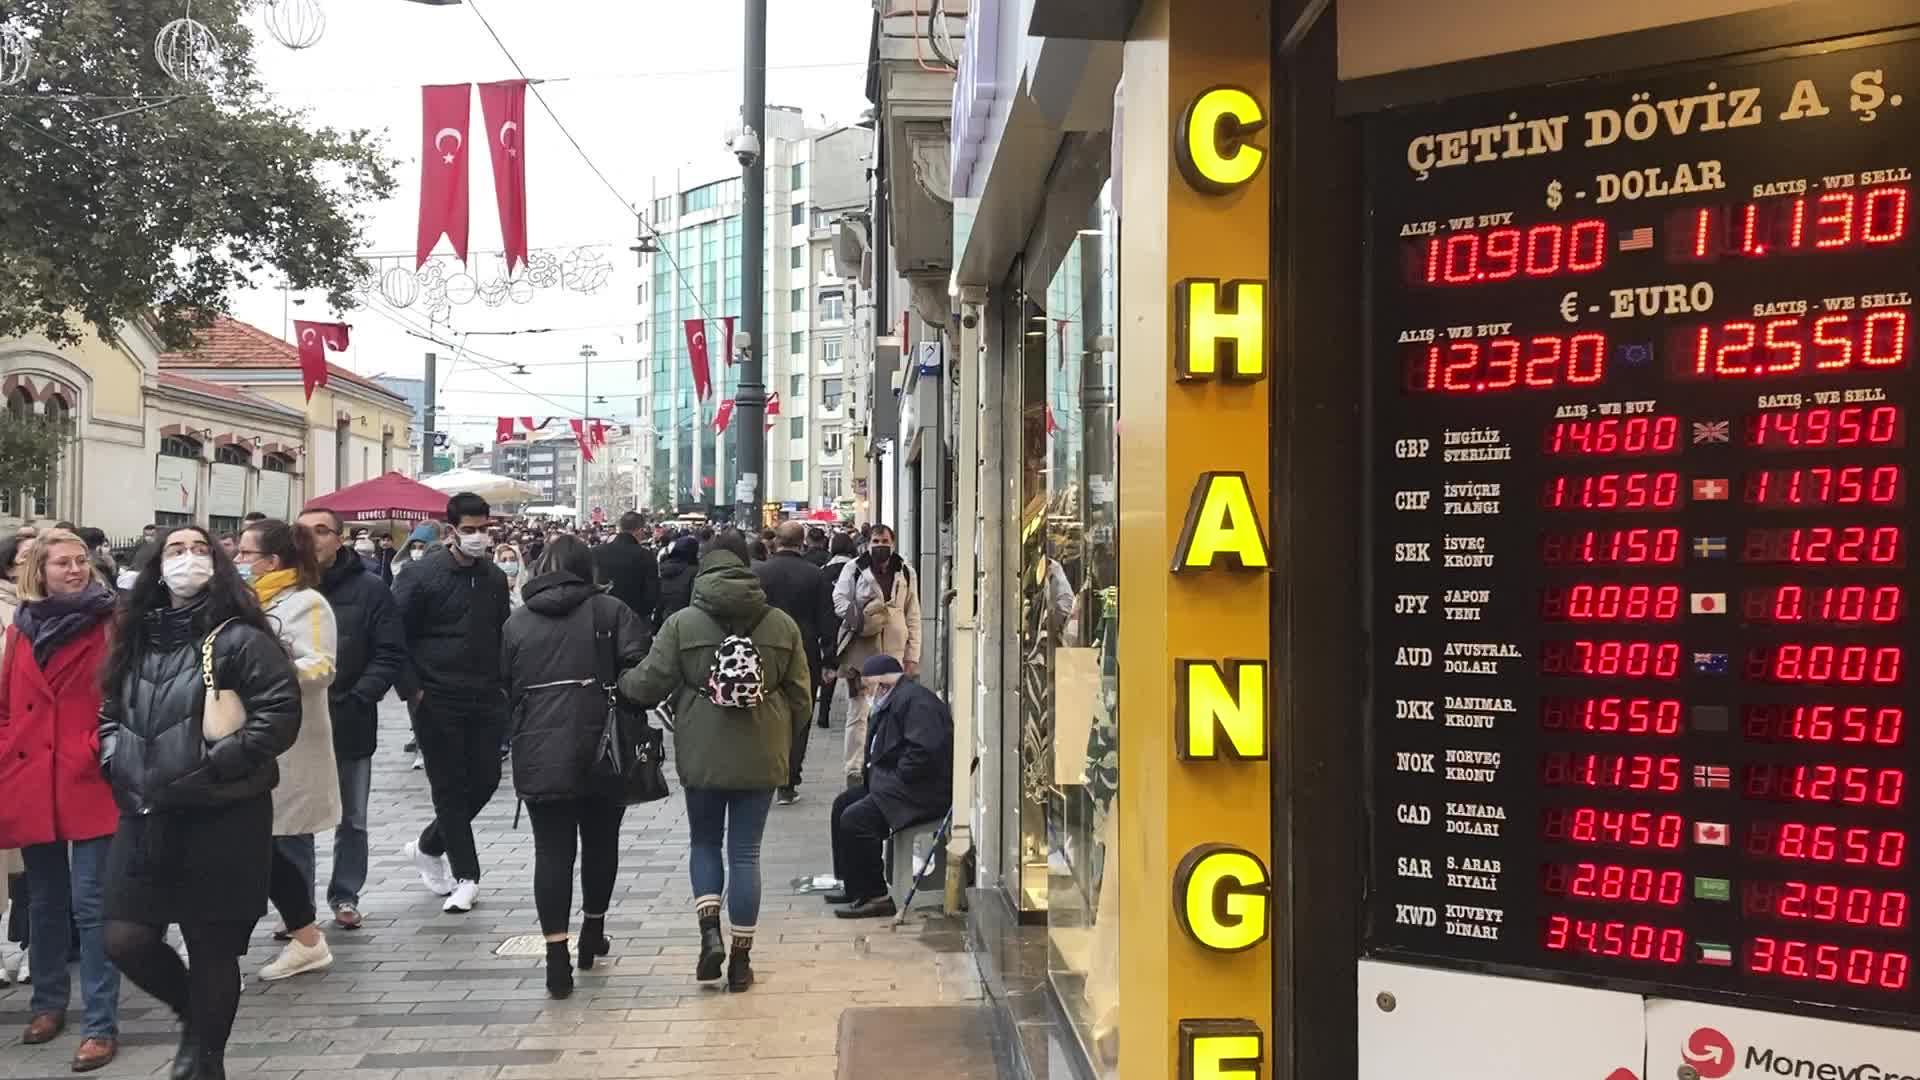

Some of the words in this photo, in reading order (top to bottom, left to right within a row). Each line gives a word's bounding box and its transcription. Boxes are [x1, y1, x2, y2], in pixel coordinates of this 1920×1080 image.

[1407, 112, 1569, 181] ÇETİN
[1584, 80, 1761, 148] DÖVİZ
[1779, 79, 1830, 121] A
[1850, 69, 1903, 122] Ş.
[1546, 179, 1563, 210] $
[1596, 160, 1726, 204] DOLAR
[1753, 180, 1807, 198] SATIŞ
[1823, 174, 1855, 189] WE
[1861, 167, 1912, 185] SELL
[1400, 221, 1436, 237] ALIŞ
[1448, 216, 1475, 231] WE
[1479, 212, 1514, 228] BUY
[1696, 187, 1907, 256] 11.130
[1427, 219, 1607, 283] 10.900
[1560, 291, 1579, 322] €
[1609, 281, 1714, 319] EURO
[1753, 300, 1808, 317] SATIŞ
[1823, 296, 1856, 311] WE
[1861, 292, 1912, 308] SELL
[1398, 328, 1435, 344] ALIŞ
[1447, 326, 1473, 340] WE
[1477, 322, 1513, 337] BUY
[1696, 311, 1906, 375] 12.550
[1426, 333, 1606, 391] 12.320
[1555, 405, 1588, 419] ALIŞ
[1599, 403, 1622, 415] WE
[1626, 400, 1656, 414] BUY
[1757, 394, 1803, 410] SATIŞ
[1814, 391, 1841, 405] WE
[1844, 387, 1886, 403] SELL
[1444, 427, 1500, 445] İNGİLİZ
[1553, 417, 1678, 452] 14.600
[1757, 406, 1897, 445] 14.950
[1395, 439, 1430, 459] GBP
[1444, 480, 1500, 500] İSVİÇRE
[1554, 473, 1679, 507] 11.550
[1758, 467, 1898, 503] 11.750
[1395, 491, 1431, 511] CHF
[1395, 543, 1431, 562] SEK
[1444, 533, 1485, 553] İSVEÇ
[1584, 529, 1679, 562] 1.150
[1790, 527, 1898, 562] 1.220
[1444, 554, 1495, 567] KRONU
[1395, 595, 1430, 614] JPY
[1444, 590, 1491, 603] JAPON
[1569, 585, 1679, 618] 0.088
[1775, 586, 1900, 621] 0.100
[1444, 607, 1481, 620] YENI
[1395, 647, 1432, 667] AUD
[1444, 643, 1522, 657] AVUSTRAL.
[1575, 642, 1680, 676] 7.800
[1444, 660, 1498, 674] DOLARI
[1776, 645, 1901, 682] 8.000
[1396, 700, 1435, 720] DKK
[1444, 696, 1517, 712] DANIMAR.
[1445, 713, 1495, 728] KRONU
[1585, 699, 1681, 734] 1.550
[1794, 706, 1902, 743] 1.650
[1396, 752, 1435, 773] NOK
[1445, 749, 1501, 769] NORVEÇ
[1445, 767, 1496, 783] KRONU
[1586, 755, 1681, 791] 1.135
[1795, 765, 1903, 804] 1.250
[1397, 804, 1432, 825] CAD
[1446, 802, 1506, 820] KANADA
[1446, 820, 1500, 837] DOLARI
[1573, 809, 1682, 848] 8.450
[1780, 823, 1905, 867] 8.650
[1397, 856, 1433, 879] SAR
[1447, 856, 1459, 869] S.
[1462, 857, 1501, 874] ARAB
[1447, 873, 1497, 891] RIYALİ
[1573, 863, 1682, 905] 2.800
[1395, 903, 1437, 927] KWD
[1445, 904, 1504, 923] KUVEYT
[1781, 881, 1906, 927] 2.900
[1446, 919, 1499, 940] DİNARI
[1547, 915, 1684, 963] 34.500
[1752, 937, 1908, 989] 36.500
[1745, 1045, 1920, 1080] MoneyG
